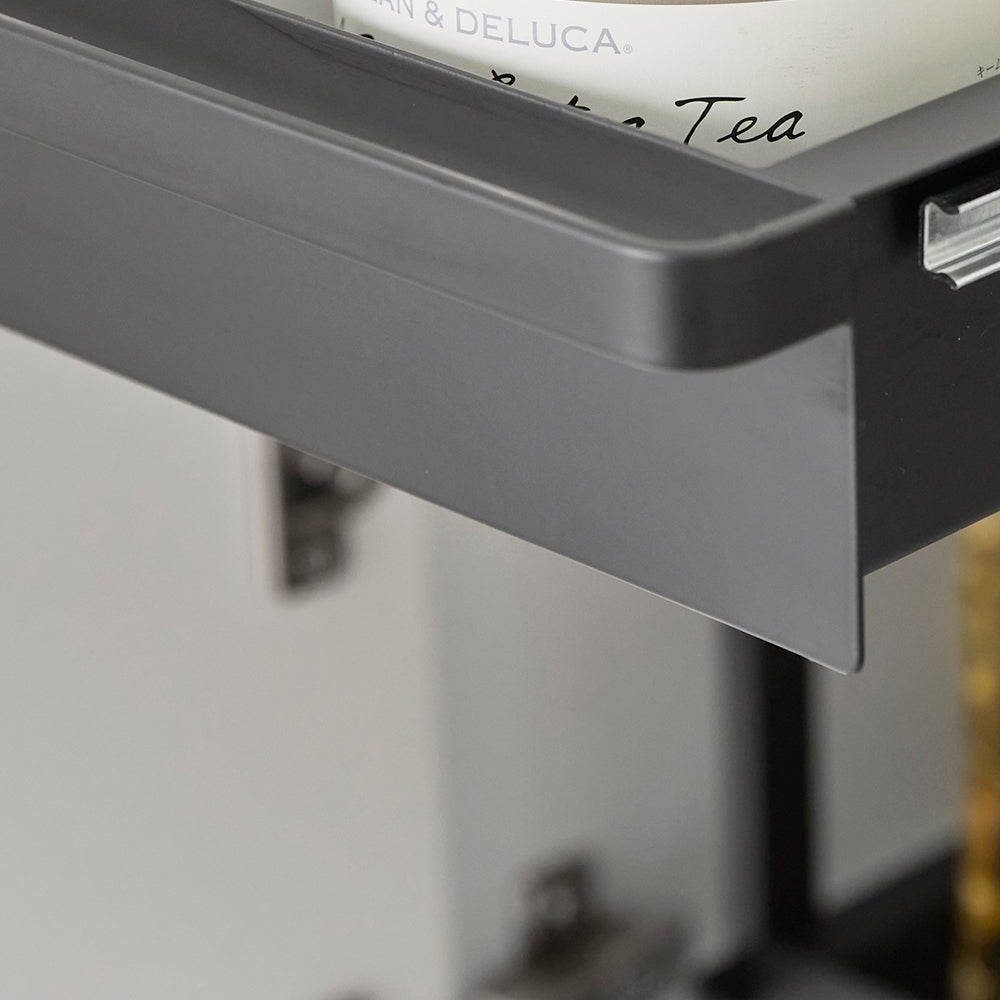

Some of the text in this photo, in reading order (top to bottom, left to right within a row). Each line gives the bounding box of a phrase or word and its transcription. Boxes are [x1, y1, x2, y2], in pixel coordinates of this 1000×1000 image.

[424, 0, 445, 29] &
[455, 6, 621, 55] DELUCA
[674, 96, 806, 145] Tea
